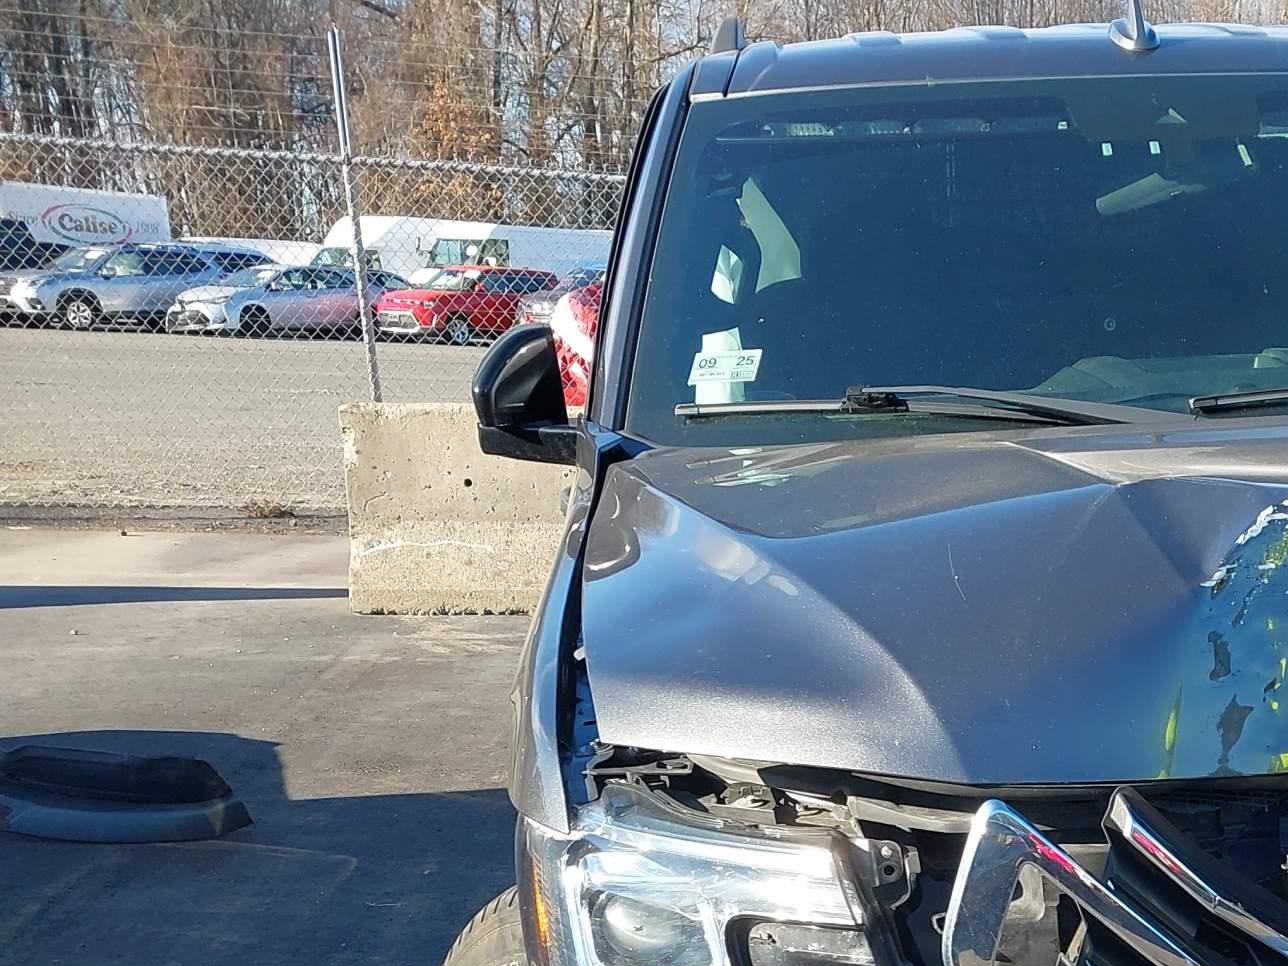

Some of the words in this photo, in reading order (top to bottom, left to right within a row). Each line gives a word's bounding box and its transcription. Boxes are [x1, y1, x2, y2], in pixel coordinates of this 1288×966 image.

[57, 213, 118, 235] Calise
[698, 357, 717, 369] 09
[735, 355, 756, 366] 25
